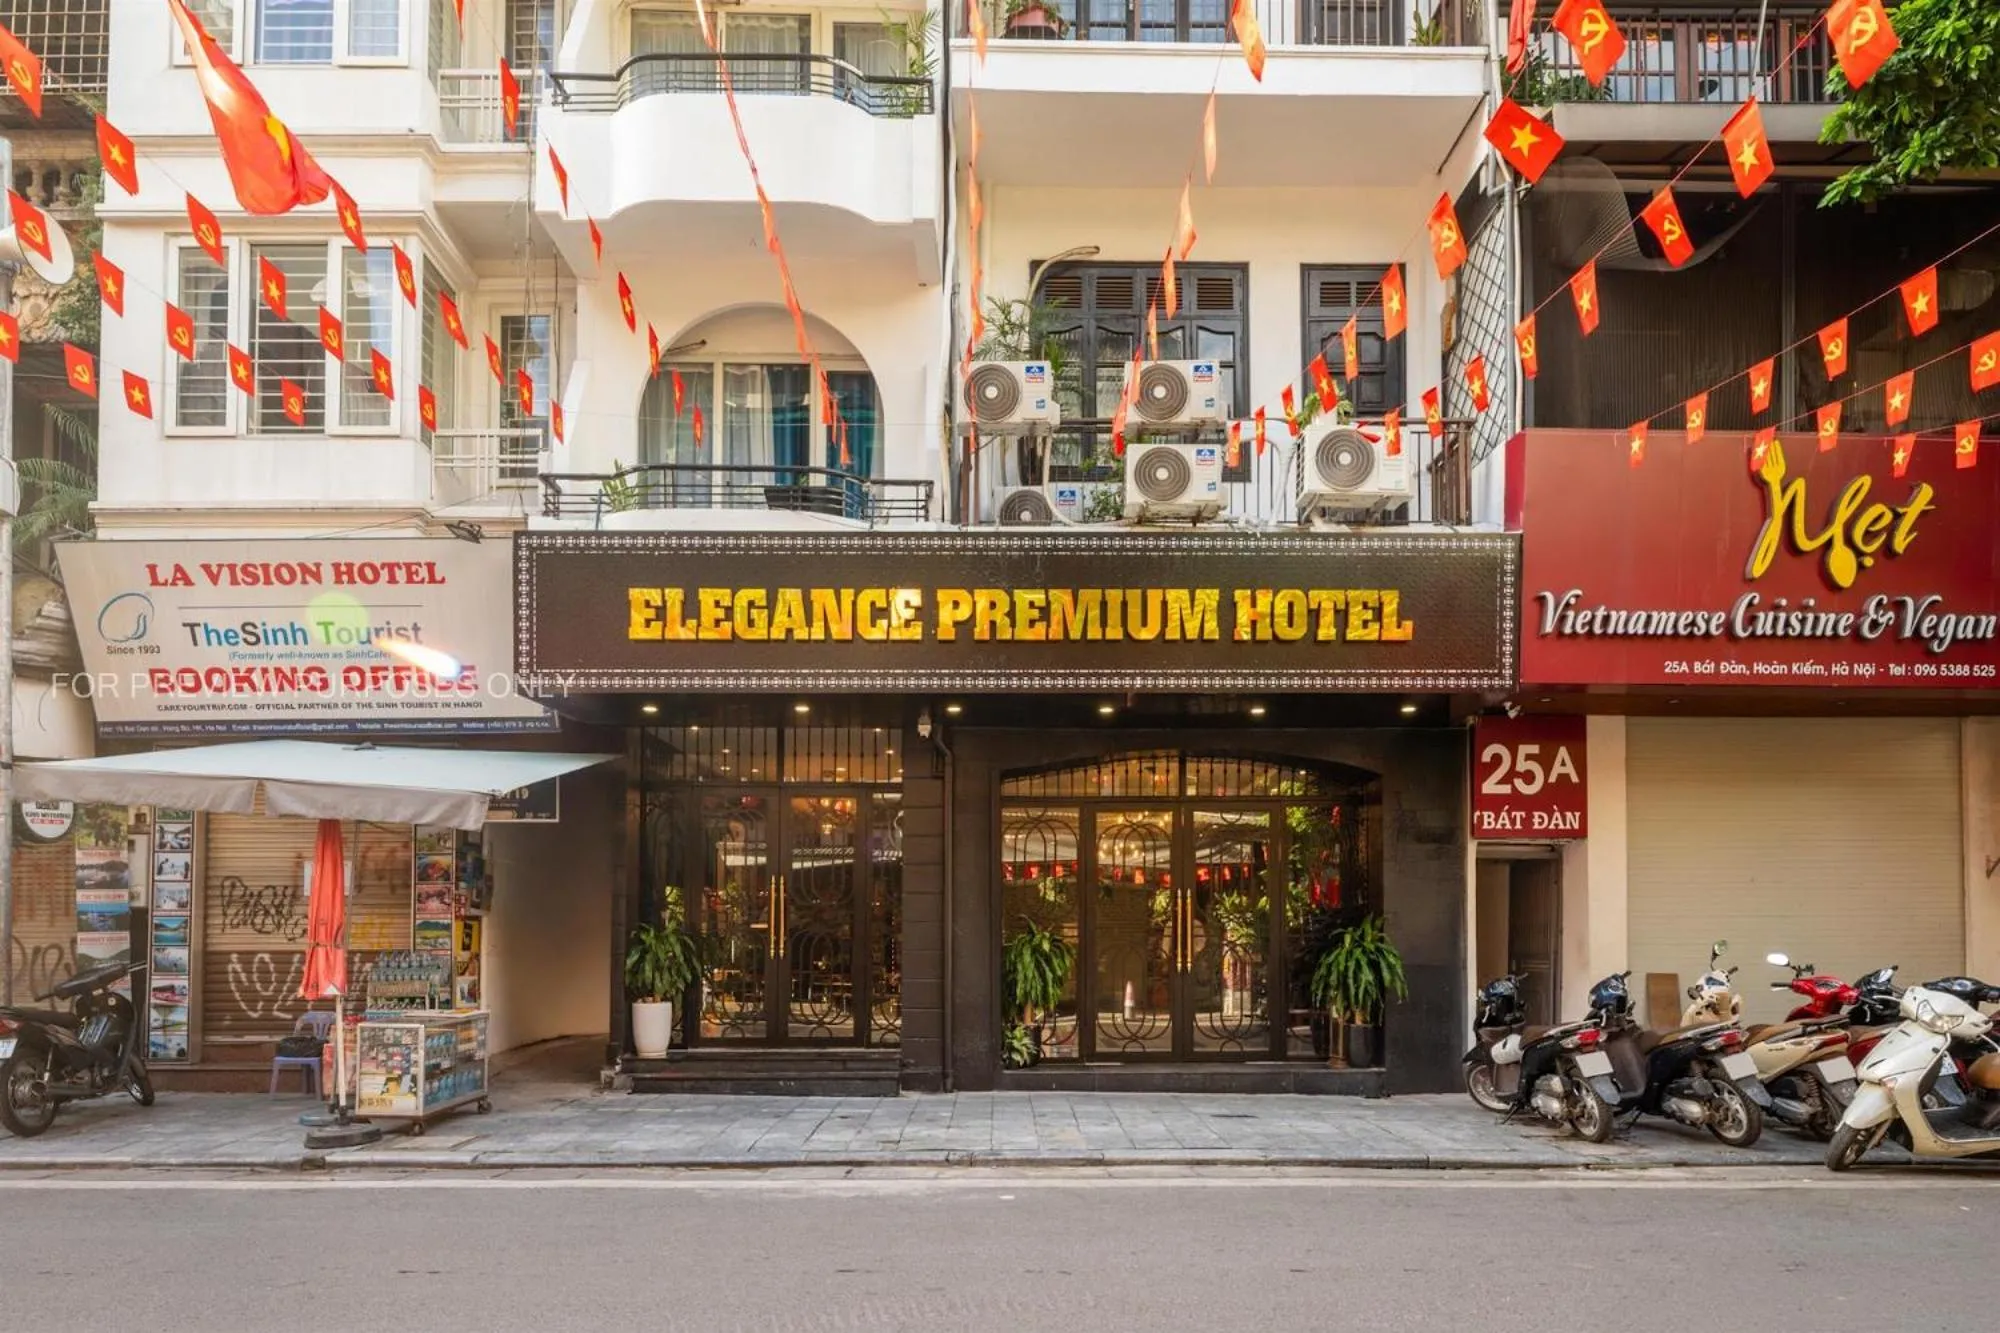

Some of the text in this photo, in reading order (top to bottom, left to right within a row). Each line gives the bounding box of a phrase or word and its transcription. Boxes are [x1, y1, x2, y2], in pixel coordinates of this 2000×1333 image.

[146, 561, 446, 587] LA VISION HOTEL
[628, 587, 1413, 641] ELEGANCE PREMIUM HOTEL
[1537, 588, 1998, 653] Vietnamese Cuisine & Vegan
[182, 620, 424, 647] TheSinh Tourist
[106, 644, 161, 655] Since 1993
[148, 665, 330, 694] BOOKING
[1664, 661, 1690, 673] 25A
[1694, 659, 1715, 674] Bát
[1720, 660, 1750, 676] Đàn,
[1753, 660, 1788, 674] Hoàn
[1831, 661, 1849, 675] Hà
[1853, 663, 1876, 678] Nội
[1914, 664, 1937, 676] 096
[1940, 664, 1970, 677] 5388
[1973, 664, 1996, 677] 525
[255, 703, 295, 711] OFFICIAL
[298, 702, 339, 710] PARTNER
[454, 701, 483, 709] HANOI
[1481, 743, 1580, 795] 25A
[1532, 805, 1581, 829] ĐÀN
